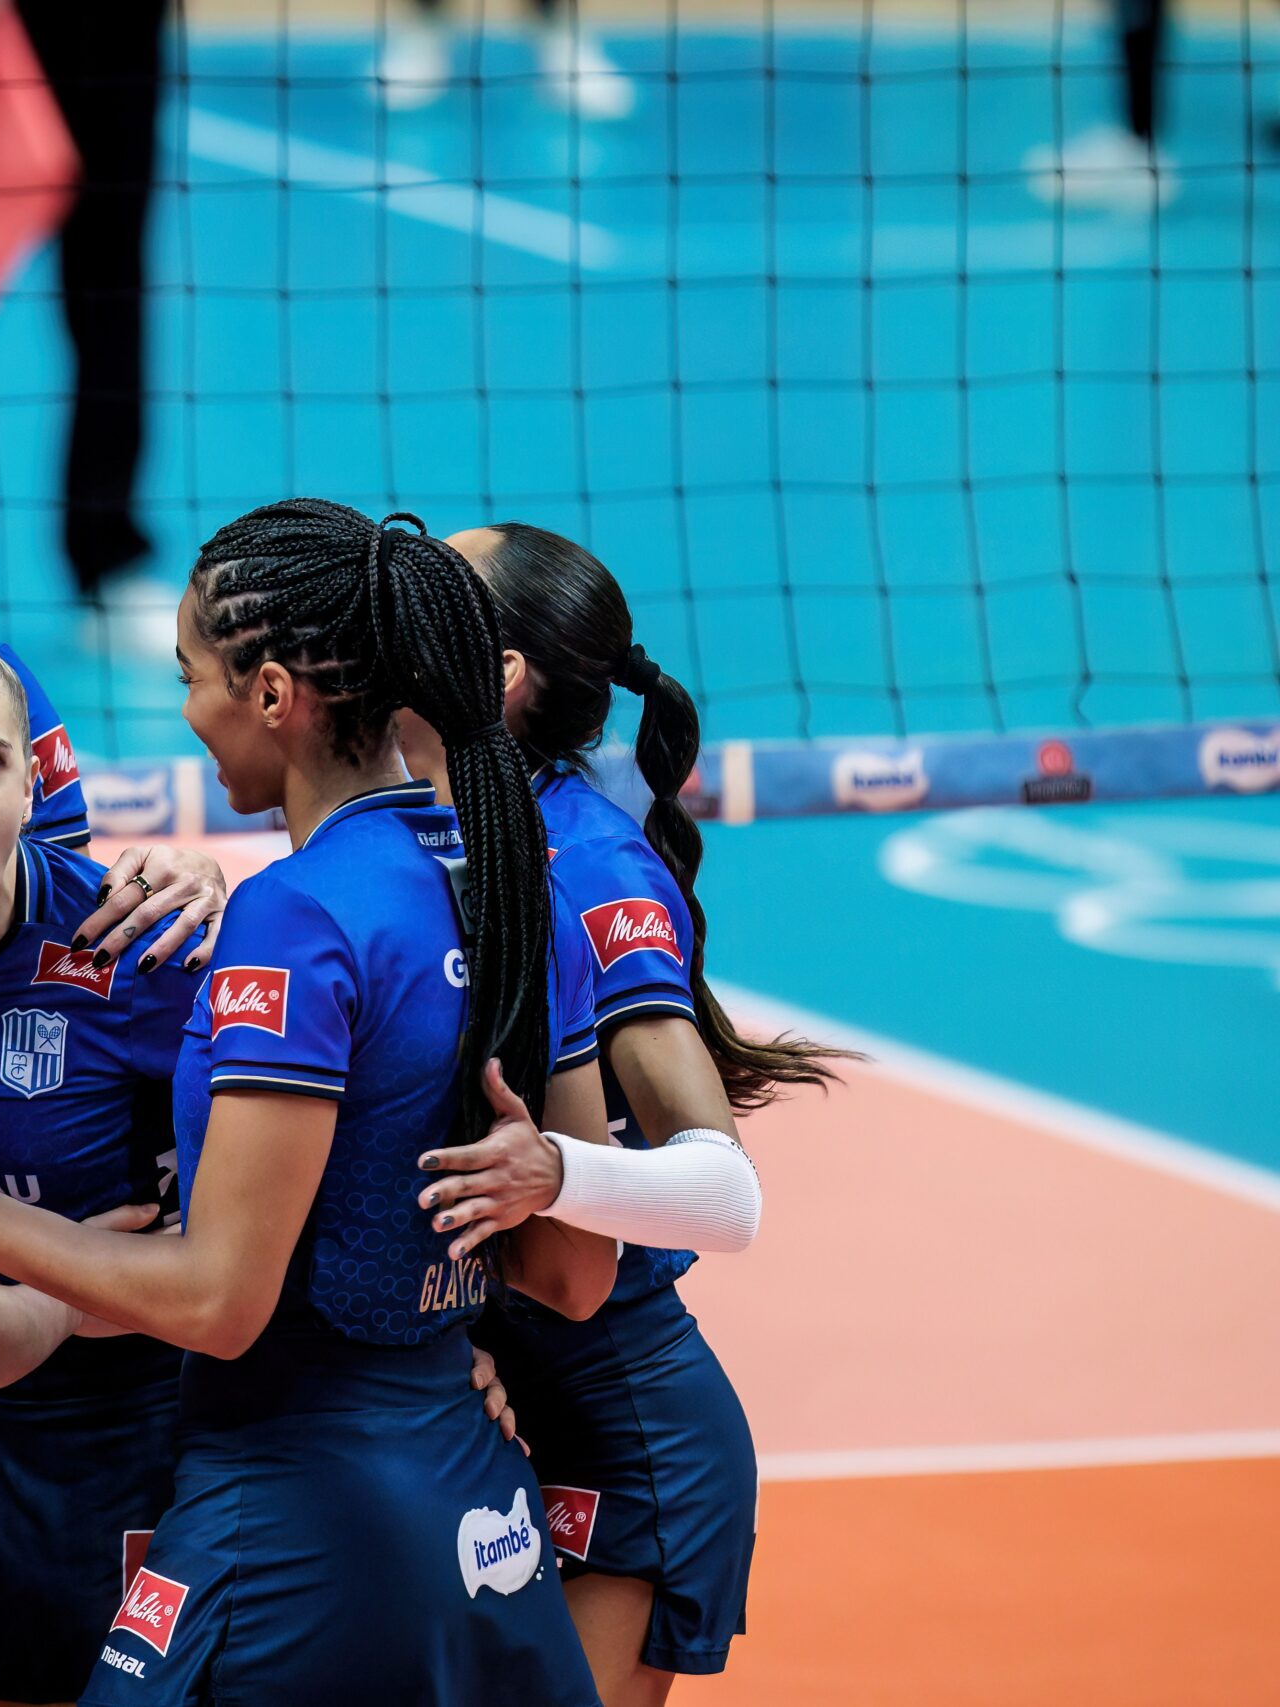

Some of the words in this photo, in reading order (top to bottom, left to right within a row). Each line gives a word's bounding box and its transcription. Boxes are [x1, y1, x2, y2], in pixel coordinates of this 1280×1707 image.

[605, 907, 673, 950] Melitta
[213, 976, 272, 1016] Melitta
[473, 1517, 531, 1571] itambé
[122, 1579, 162, 1628] Melitta
